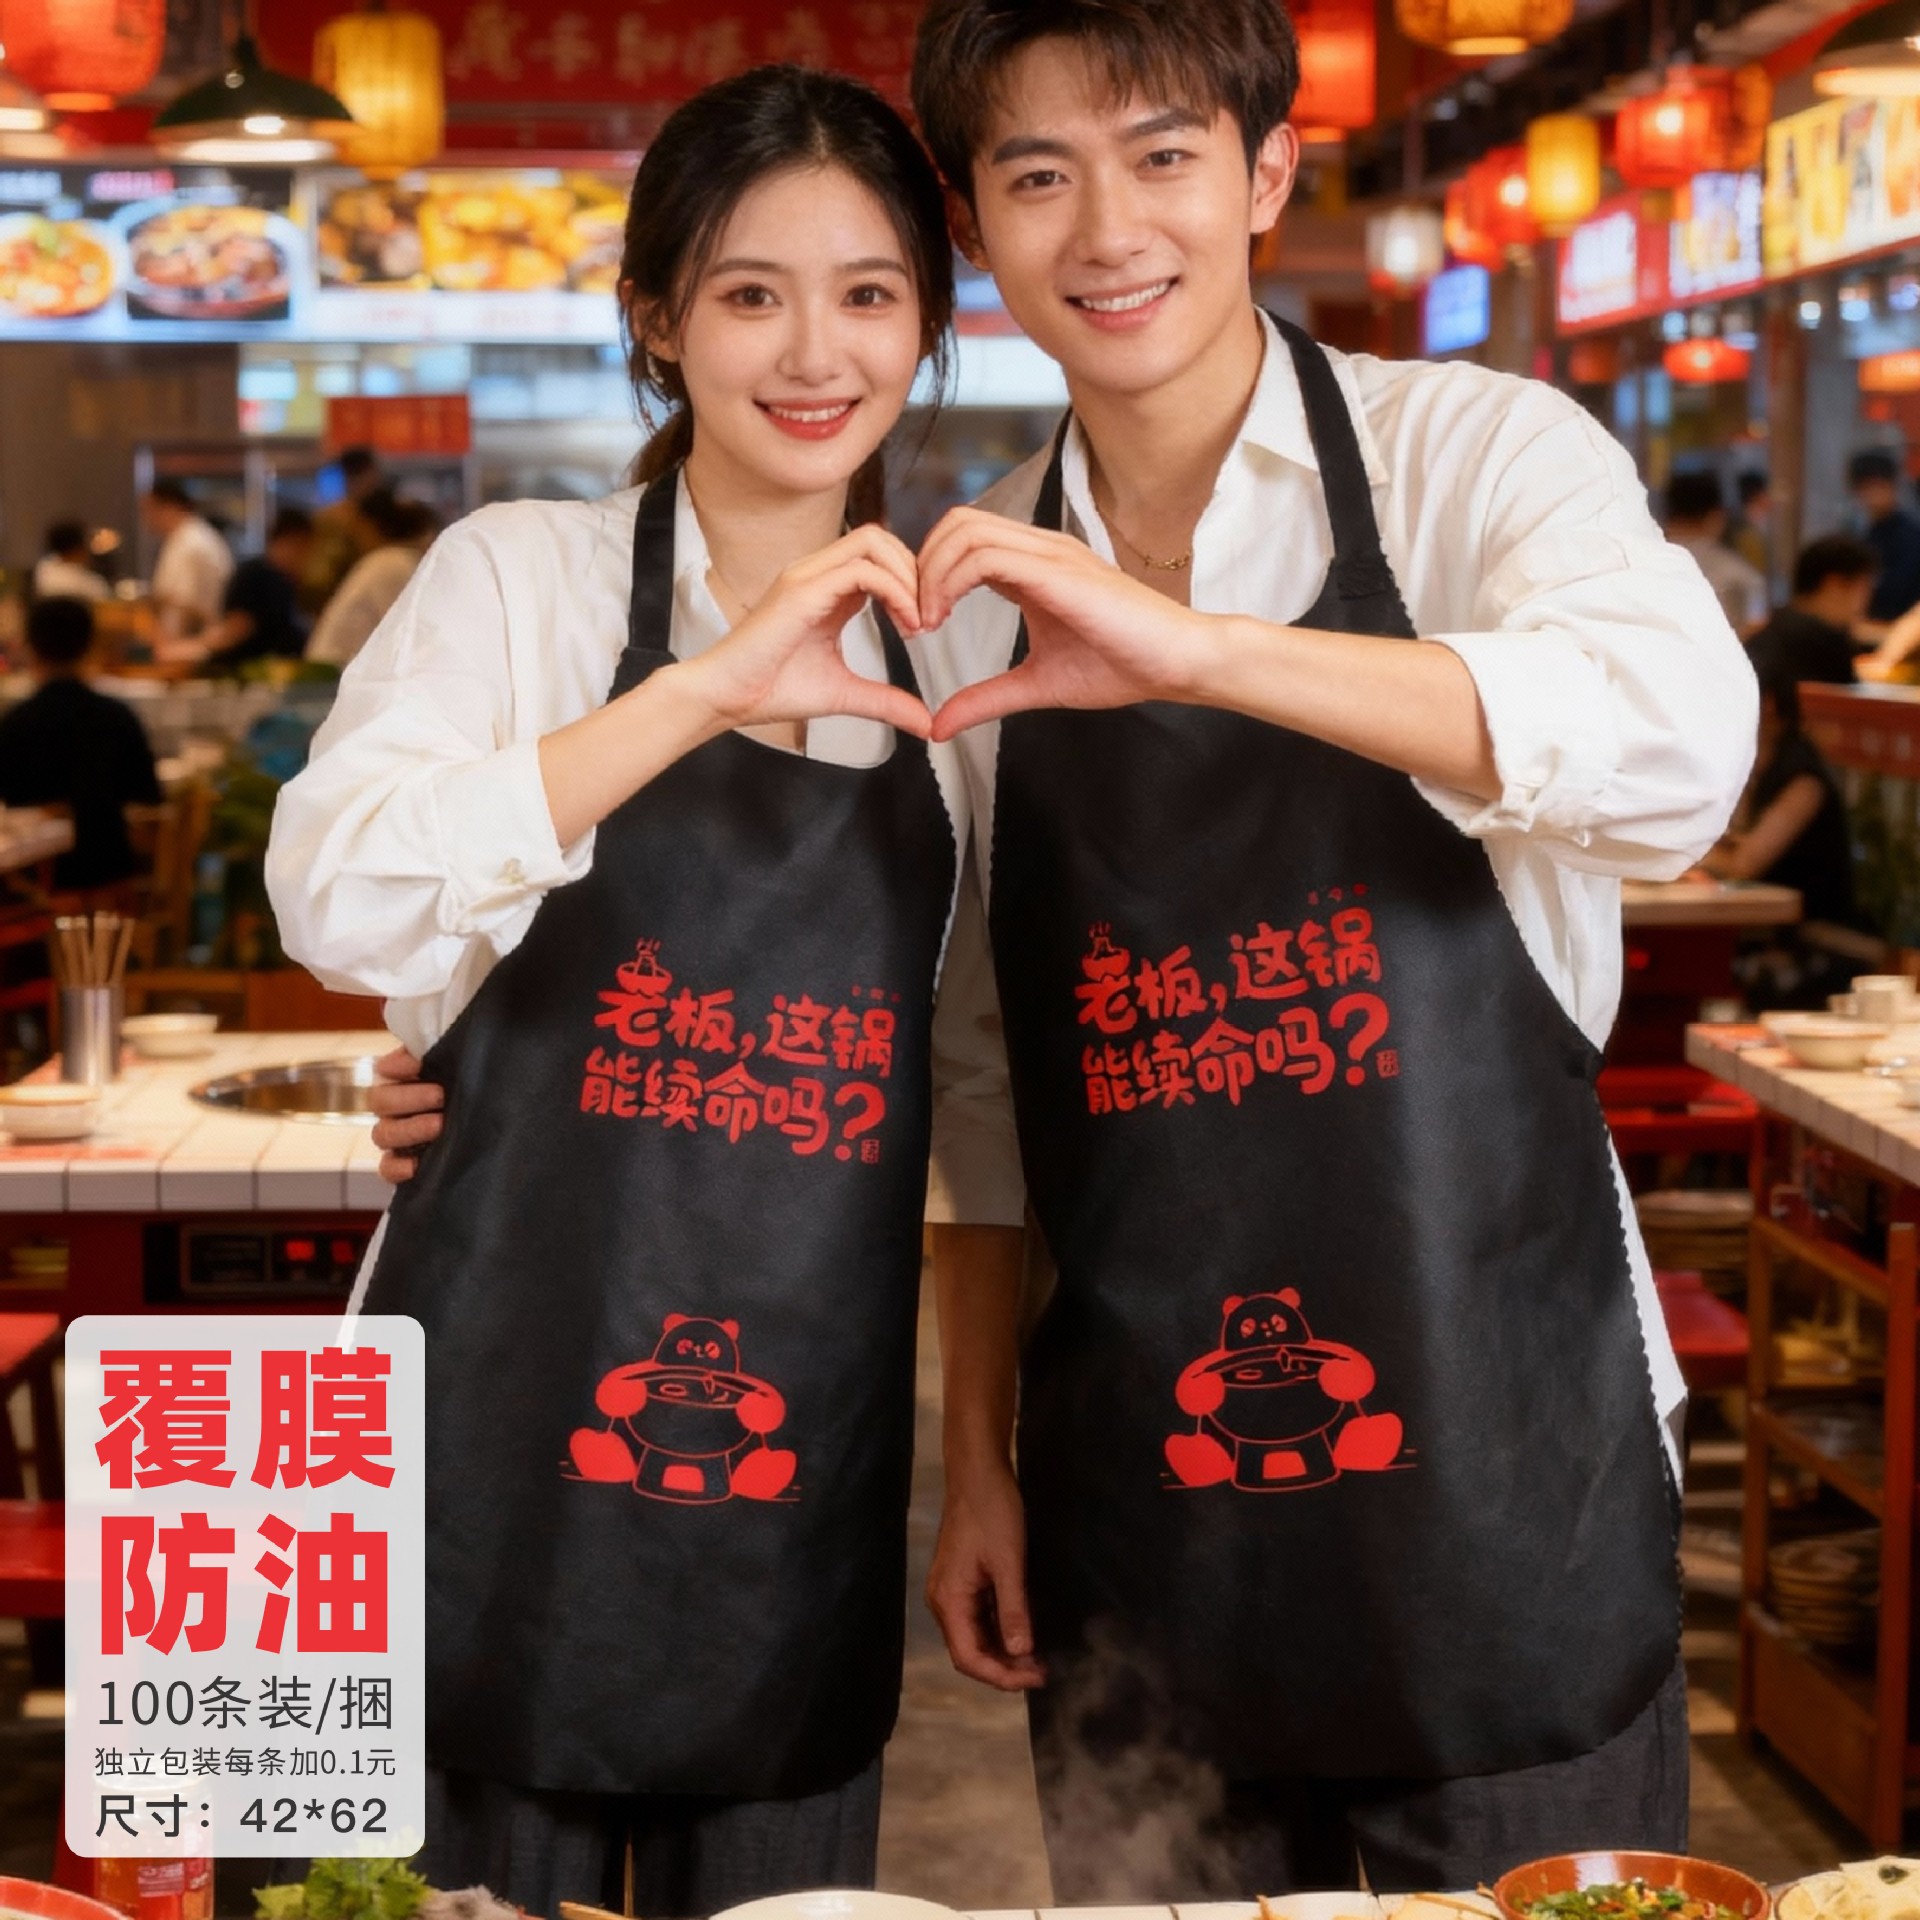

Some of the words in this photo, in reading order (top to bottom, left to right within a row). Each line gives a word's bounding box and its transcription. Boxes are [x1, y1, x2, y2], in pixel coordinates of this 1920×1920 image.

[594, 960, 896, 1078] 老板，这锅
[1075, 906, 1383, 1034] 老板，这锅
[580, 1047, 887, 1161] 能续命吗？
[1081, 992, 1390, 1115] 能续命吗？
